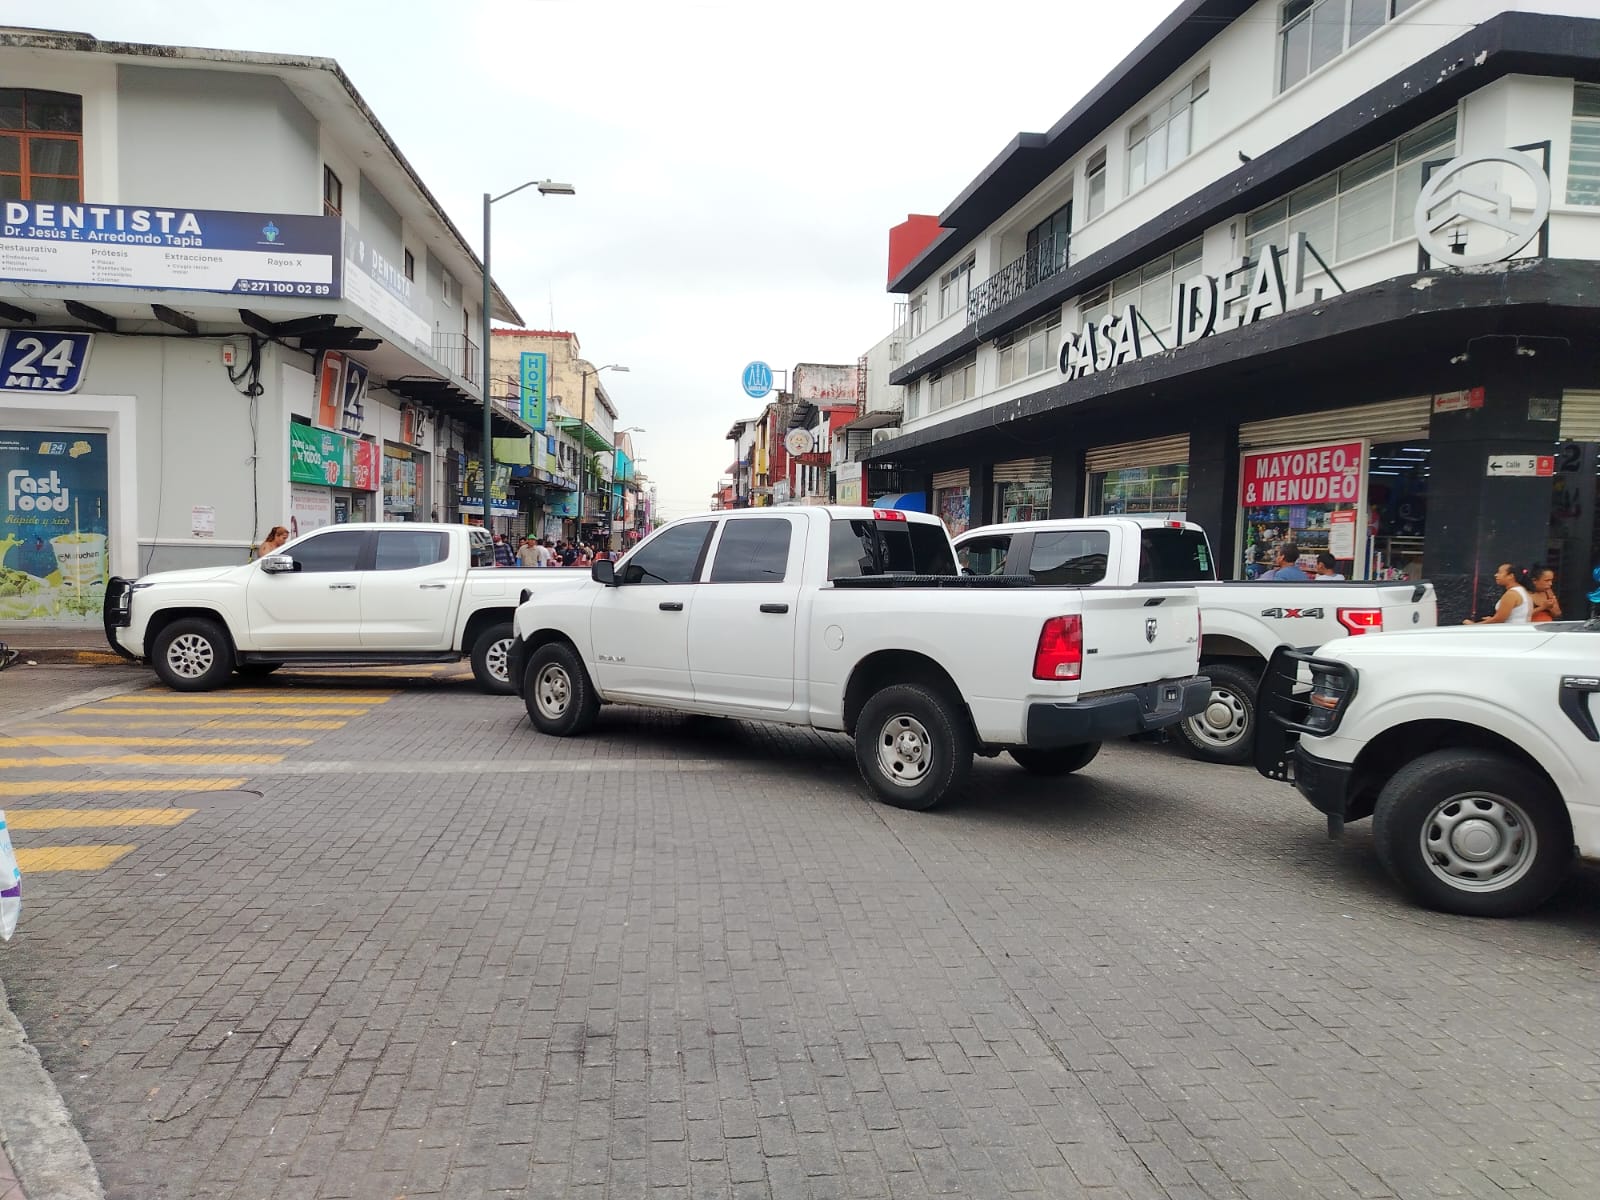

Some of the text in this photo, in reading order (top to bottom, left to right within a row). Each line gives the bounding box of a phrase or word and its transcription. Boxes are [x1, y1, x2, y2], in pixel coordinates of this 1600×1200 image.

[6, 202, 202, 235] DENTISTA
[4, 225, 203, 249] Dr. Jesús E. Arredondo Tapia
[91, 248, 129, 258] Prótesis
[164, 252, 223, 263] Extracciones
[267, 258, 303, 267] Rayos X
[251, 281, 329, 295] 271 100 02 89
[1174, 232, 1324, 347] IDEAL
[1057, 304, 1143, 382] CASA
[9, 337, 76, 376] 24
[4, 375, 65, 390] MIX
[528, 358, 539, 420] HOTEL
[1256, 449, 1347, 480] MAYOREO
[1505, 459, 1535, 469] Calle 5
[1246, 475, 1357, 503] & MENUDEO
